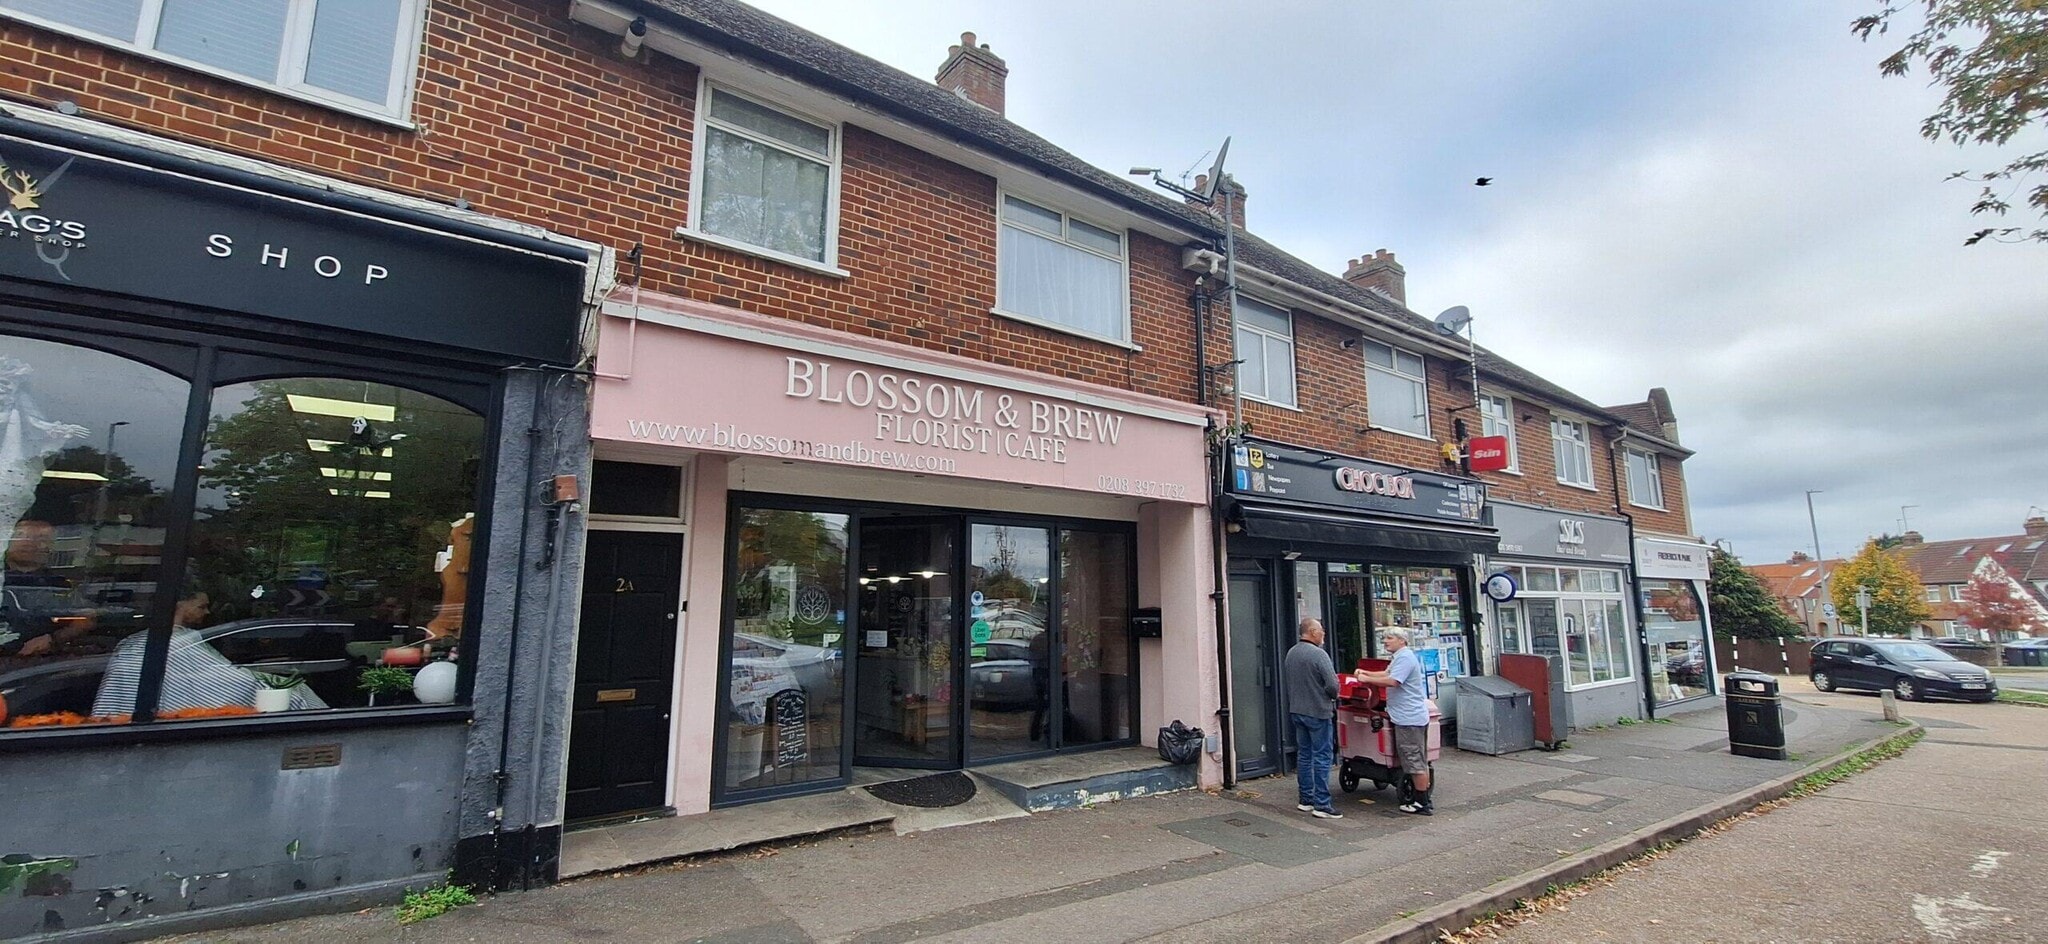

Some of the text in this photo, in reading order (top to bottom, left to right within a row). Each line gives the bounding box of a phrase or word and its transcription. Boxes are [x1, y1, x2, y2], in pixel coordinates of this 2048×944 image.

[34, 234, 87, 248] SHOP
[205, 233, 389, 286] SHOP
[785, 356, 1123, 446] BLOSSOM & BREW
[875, 412, 1067, 464] FLORIST CAFE
[1473, 448, 1501, 459] Sun
[1097, 475, 1186, 500] 0208 397 1732
[1559, 519, 1585, 545] SLS
[616, 578, 634, 592] 2A
